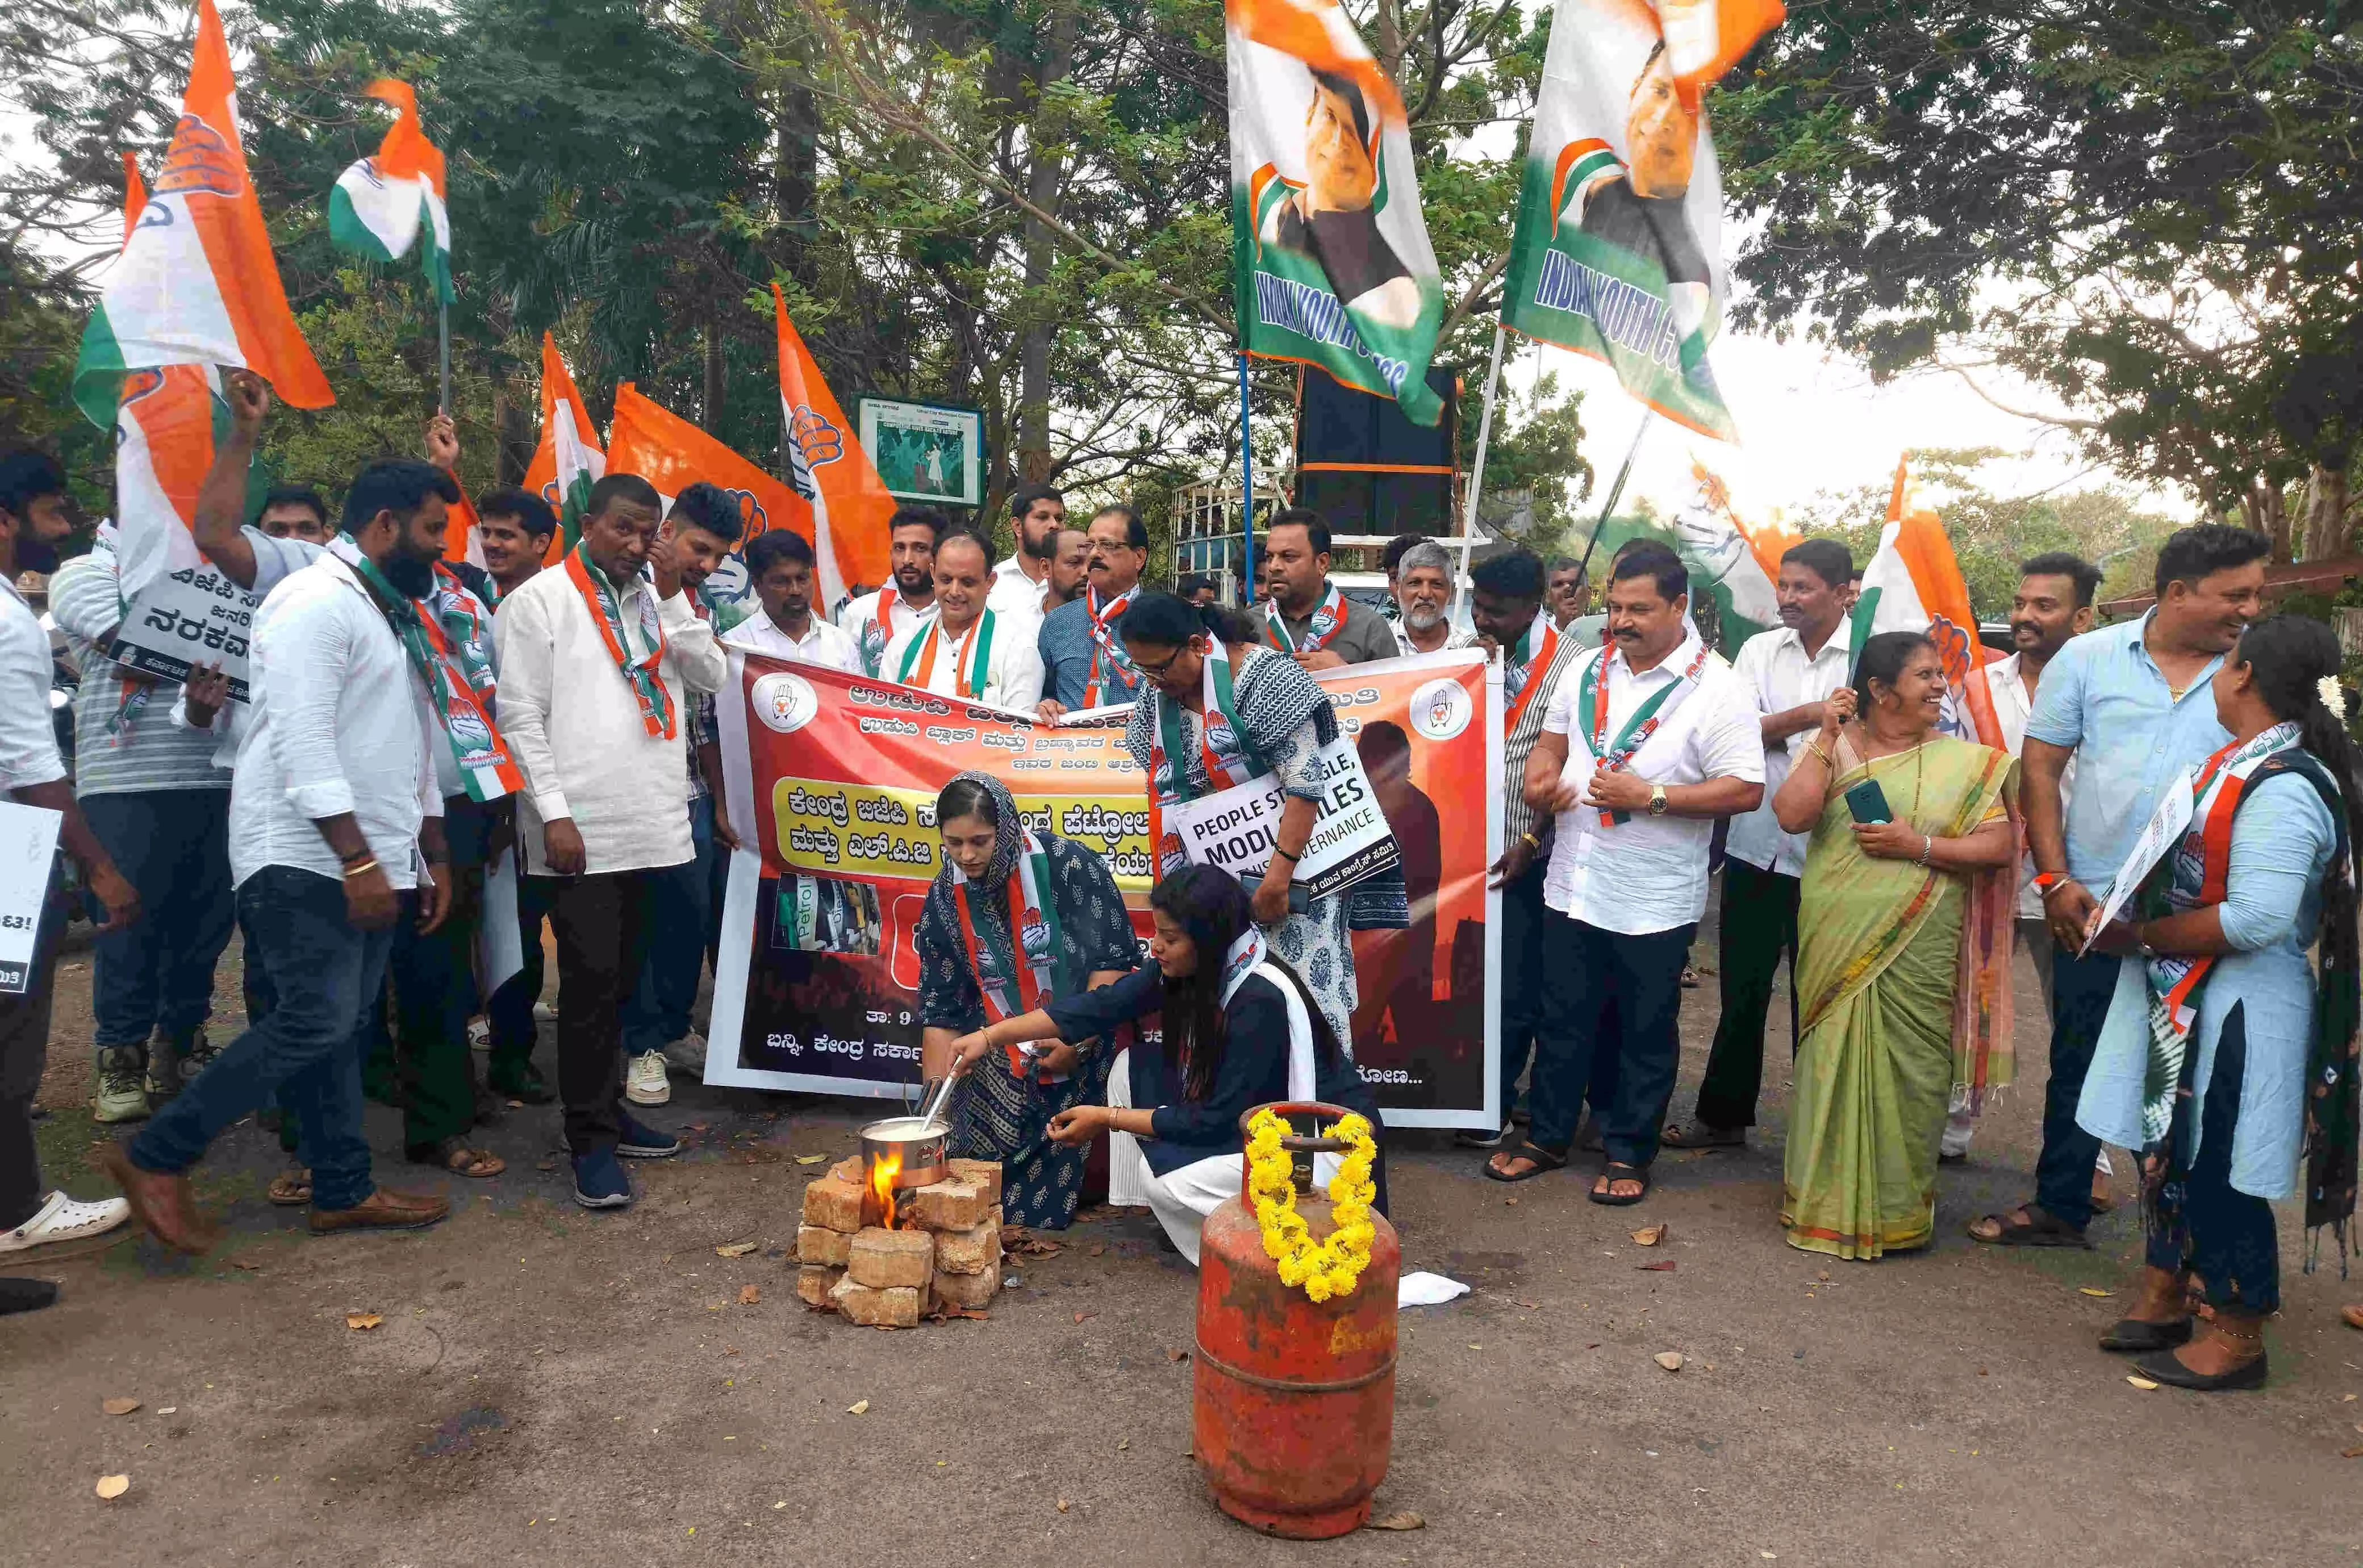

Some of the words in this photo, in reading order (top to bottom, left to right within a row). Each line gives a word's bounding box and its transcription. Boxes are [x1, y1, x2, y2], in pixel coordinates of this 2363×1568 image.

[861, 717, 920, 734] ಉಡುಪಿ
[982, 733, 1027, 752] ಮತ್ತು
[788, 787, 849, 827] ಕೇಂದ್ರ
[857, 796, 908, 825] ಬಿಜೆಪಿ
[1193, 799, 1264, 841] PEOPLE
[791, 823, 840, 864] ಮತ್ತು
[848, 833, 932, 864] ಎಲ್.ಪಿ.ಜಿ
[1204, 823, 1276, 864] MODI
[799, 885, 812, 937] Petrol
[814, 1034, 864, 1060] ಕೇಂದ್ರ
